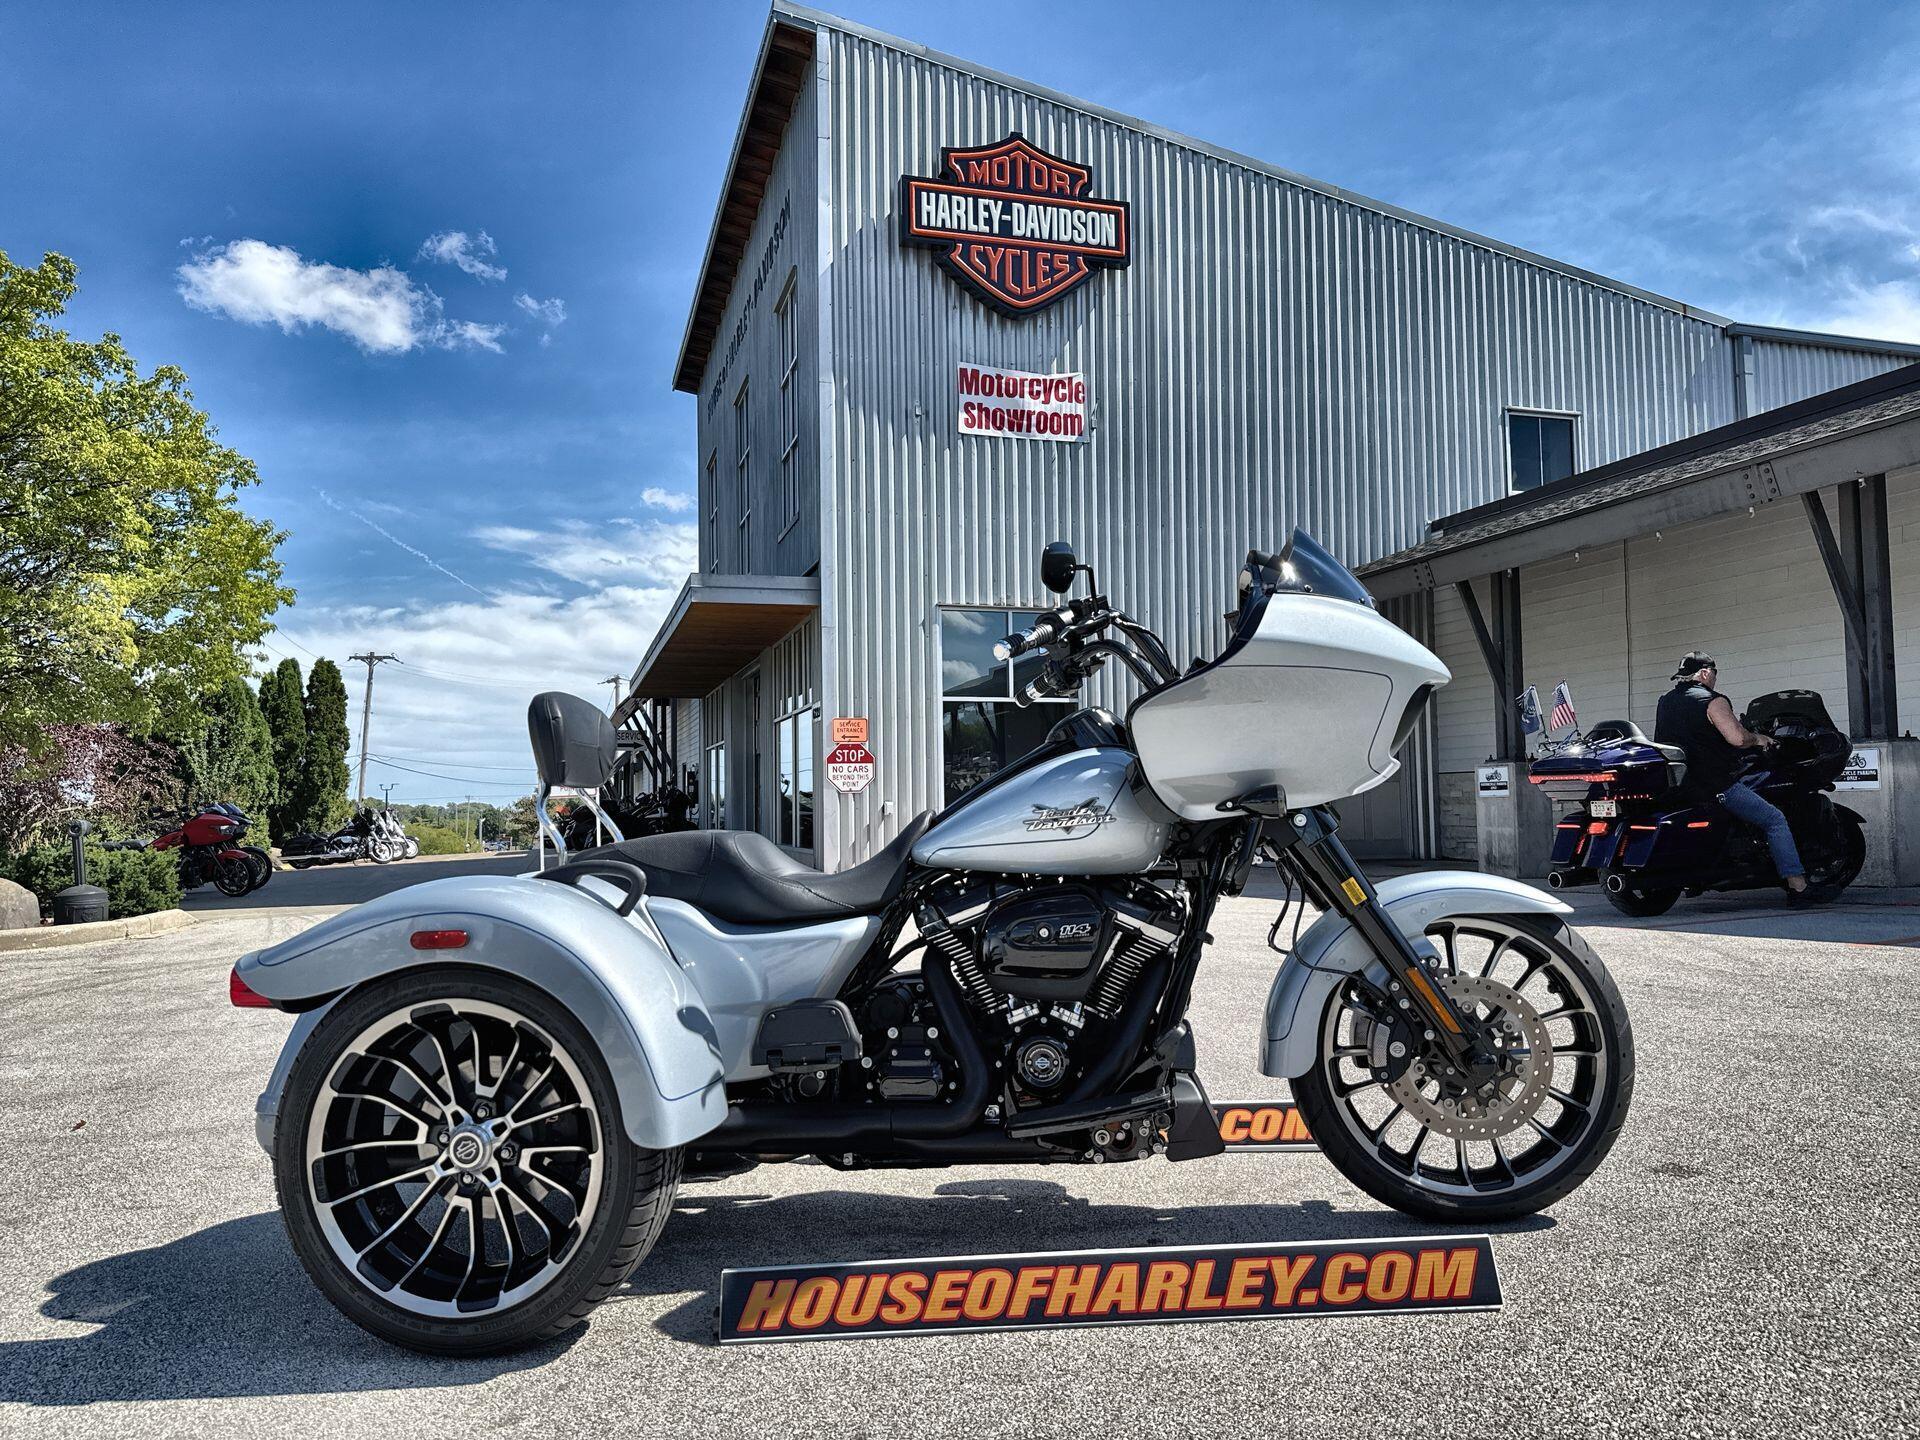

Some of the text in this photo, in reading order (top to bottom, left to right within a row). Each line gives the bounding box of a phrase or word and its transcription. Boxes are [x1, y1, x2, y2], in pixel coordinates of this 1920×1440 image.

[968, 151, 1070, 195] MOTOR
[920, 191, 1116, 247] HARLEY-DAVIDSON
[969, 244, 1070, 296] CYCLES
[959, 367, 1086, 405] Motorcycle
[963, 402, 1083, 437] Showroom
[832, 765, 869, 773] NO CARS
[835, 750, 865, 762] STOP
[1059, 923, 1091, 936] 114
[736, 1247, 1480, 1333] HOUSEOFHARLEY.COM
